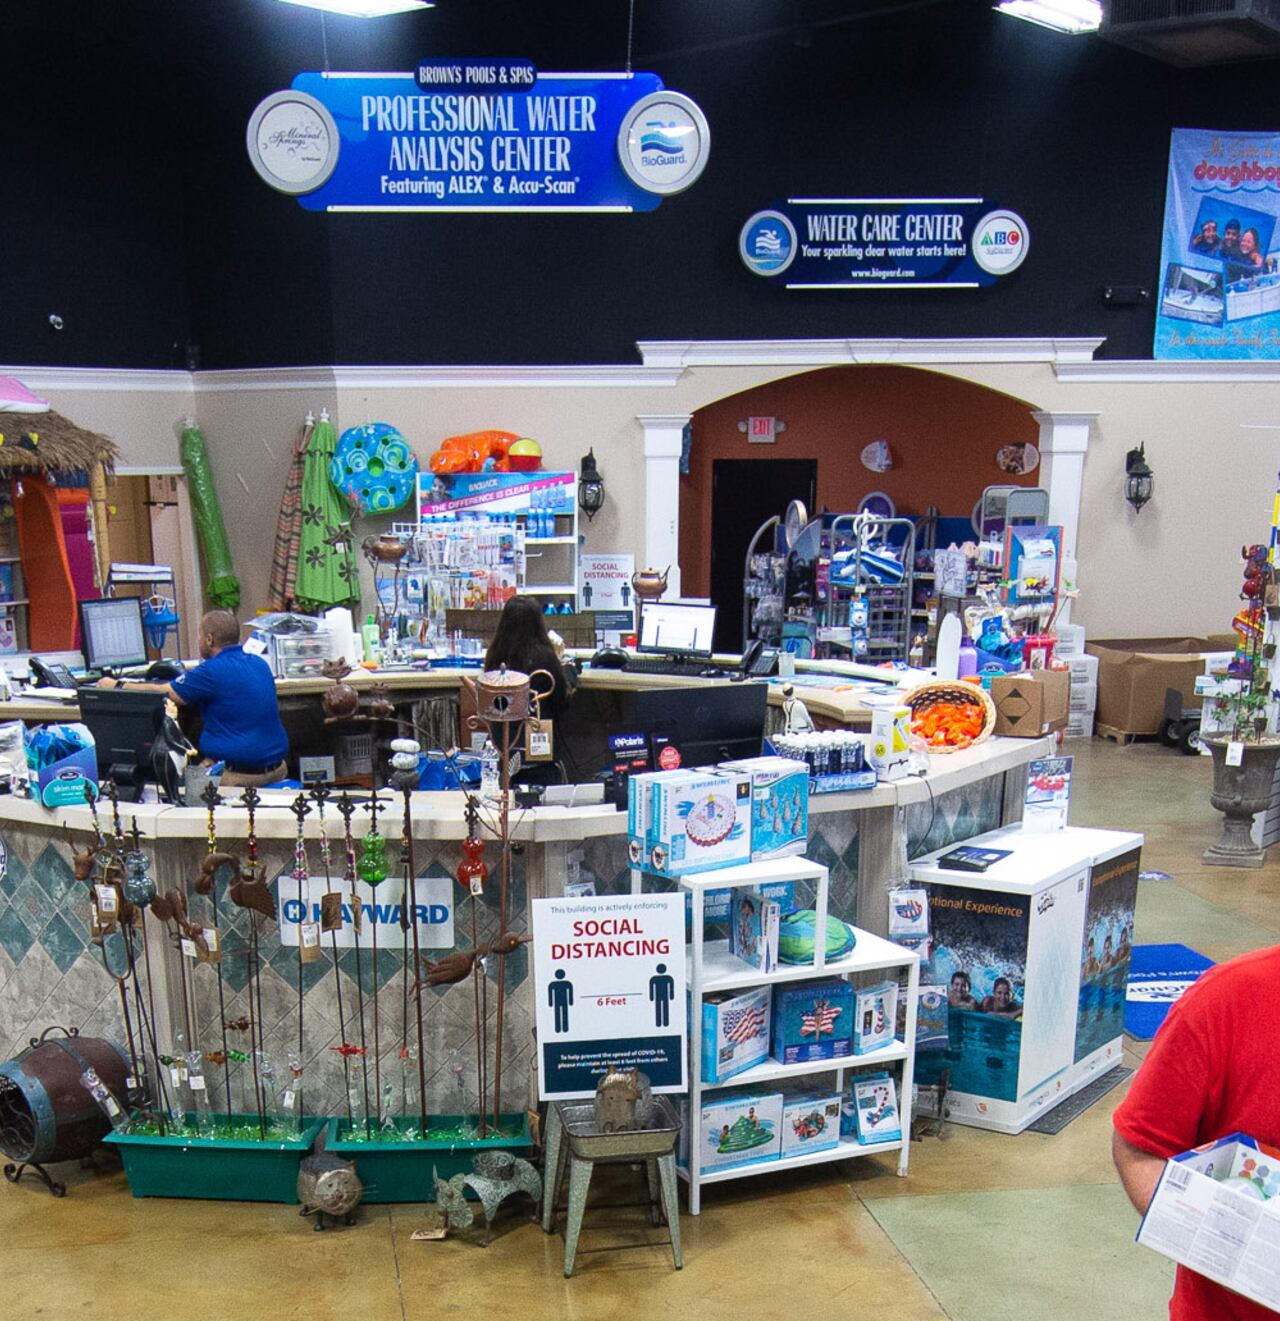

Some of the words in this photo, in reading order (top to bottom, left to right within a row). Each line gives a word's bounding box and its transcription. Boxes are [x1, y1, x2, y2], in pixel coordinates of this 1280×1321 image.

[419, 66, 462, 84] BROWN'S
[466, 67, 496, 84] POOLS
[498, 67, 508, 84] &
[509, 67, 534, 84] SPAS
[361, 96, 519, 131] PROFESSIONAL
[527, 96, 596, 131] WATER
[389, 136, 484, 172] ANALYSIS
[491, 136, 571, 172] CENTER
[381, 175, 445, 199] Featuring
[493, 176, 505, 194] &
[807, 214, 857, 242] WATER
[862, 214, 901, 242] CARE
[905, 214, 964, 241] CENTER
[801, 244, 821, 258] Your
[823, 244, 863, 260] sparkling
[865, 244, 885, 257] clear
[888, 246, 914, 257] water
[917, 245, 942, 257] starts
[943, 244, 967, 257] here!
[851, 268, 915, 279] www.bioguard.com
[431, 504, 447, 513] THE
[448, 493, 494, 510] DIFFERENCE
[505, 484, 530, 498] CLEAR
[583, 571, 629, 579] DISTANCING
[592, 563, 618, 571] SOCIAL
[551, 906, 565, 914] This
[567, 904, 597, 914] building
[598, 904, 604, 912] is
[606, 902, 632, 912] actively
[634, 901, 668, 911] enforcing
[965, 900, 1024, 918] Experience
[573, 918, 643, 937] SOCIAL
[551, 939, 670, 960] DISTANCING
[605, 997, 627, 1006] Feet
